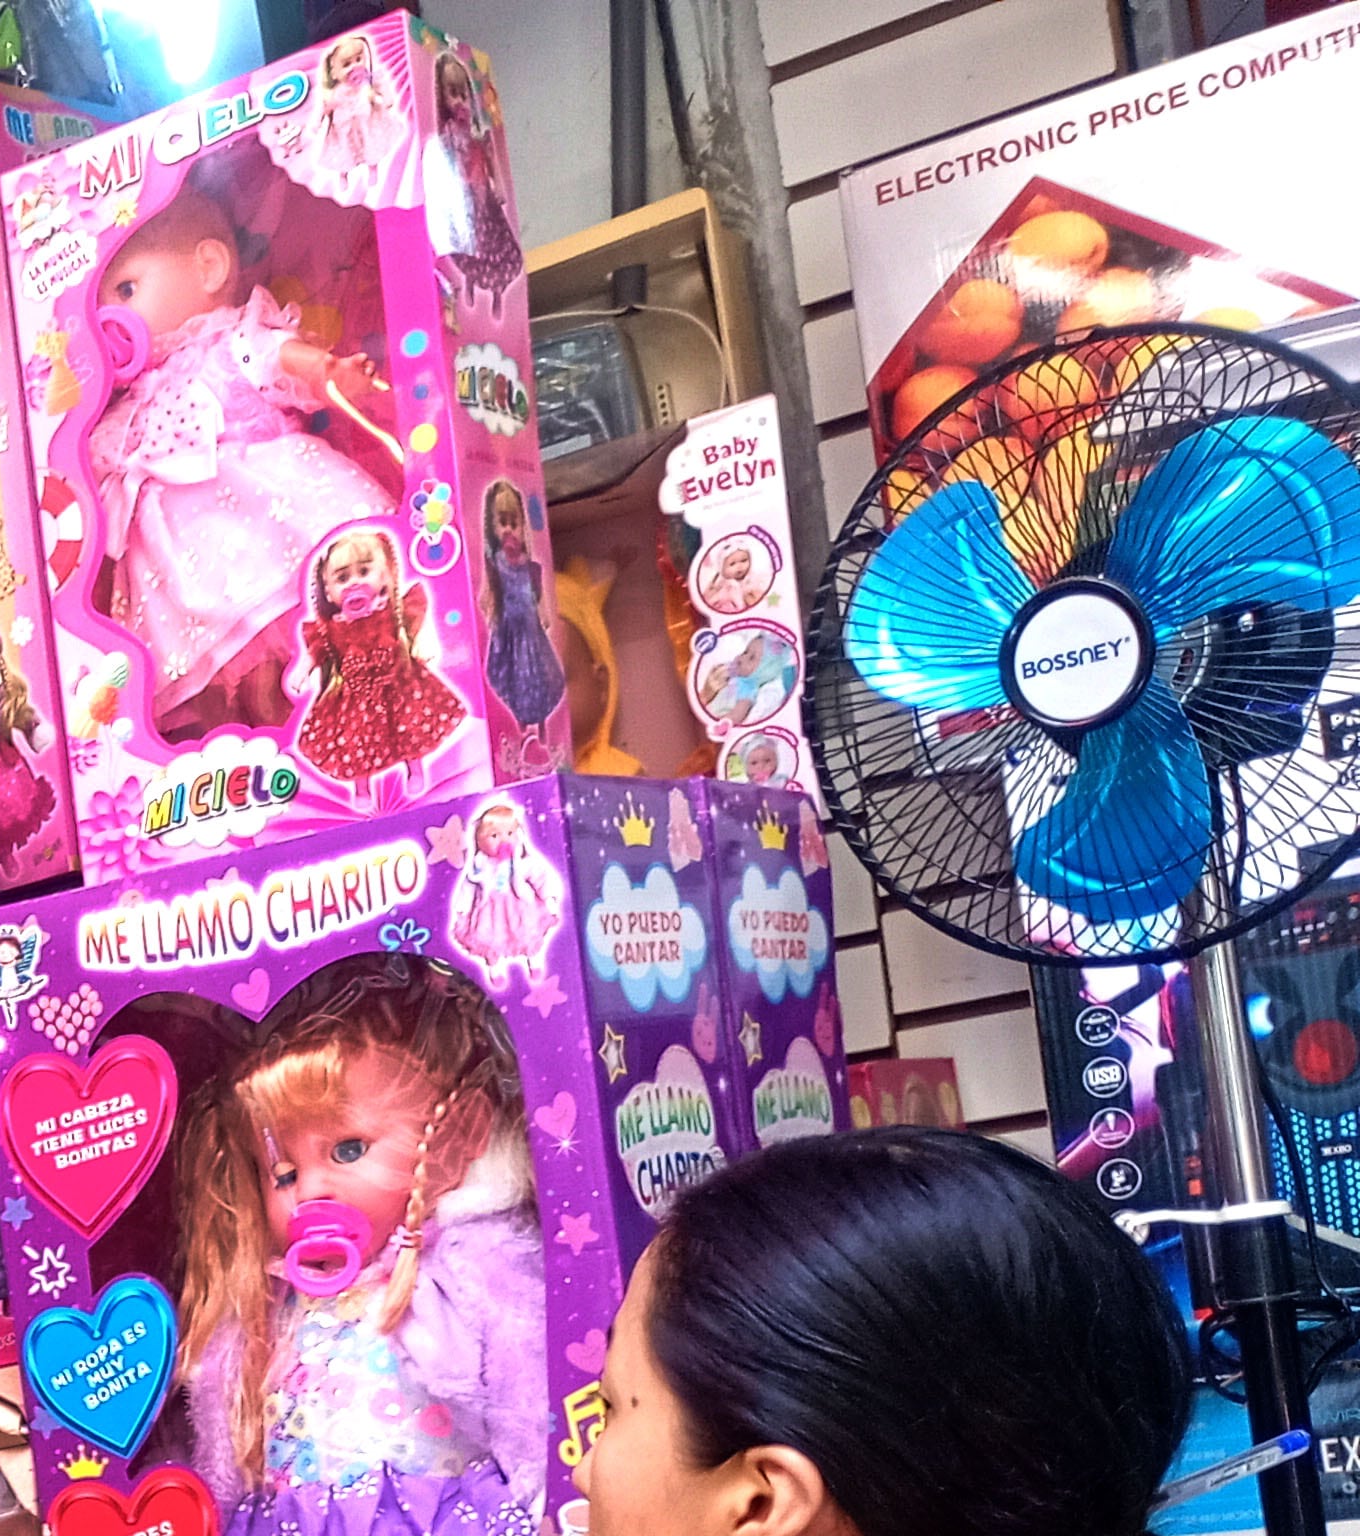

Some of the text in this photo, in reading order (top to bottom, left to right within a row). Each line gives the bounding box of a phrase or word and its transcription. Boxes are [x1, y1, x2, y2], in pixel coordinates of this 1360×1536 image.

[80, 132, 142, 198] MI
[875, 121, 1078, 206] ELECTRONIC
[1088, 83, 1189, 136] PRICE
[703, 436, 758, 466] Baby
[682, 457, 776, 503] Evelyn
[1021, 638, 1122, 680] BOSSNEY
[144, 765, 297, 834] MI CIELO
[85, 851, 419, 964] ME LLAMO CHARITO
[599, 910, 683, 936] YO PUEDO
[739, 908, 810, 932] YO PUEDO
[613, 939, 681, 966] CANTAR
[751, 936, 808, 962] CANTAR
[1088, 1066, 1122, 1086] USB
[30, 1108, 148, 1157] TIENE LUCES
[34, 1093, 136, 1136] MI CABEZA
[646, 1085, 711, 1139] LLAMO
[53, 1132, 138, 1169] BONITAS
[50, 1320, 148, 1391] MI ROPA ES
[86, 1354, 125, 1388] MUY
[82, 1360, 153, 1411] BONITA
